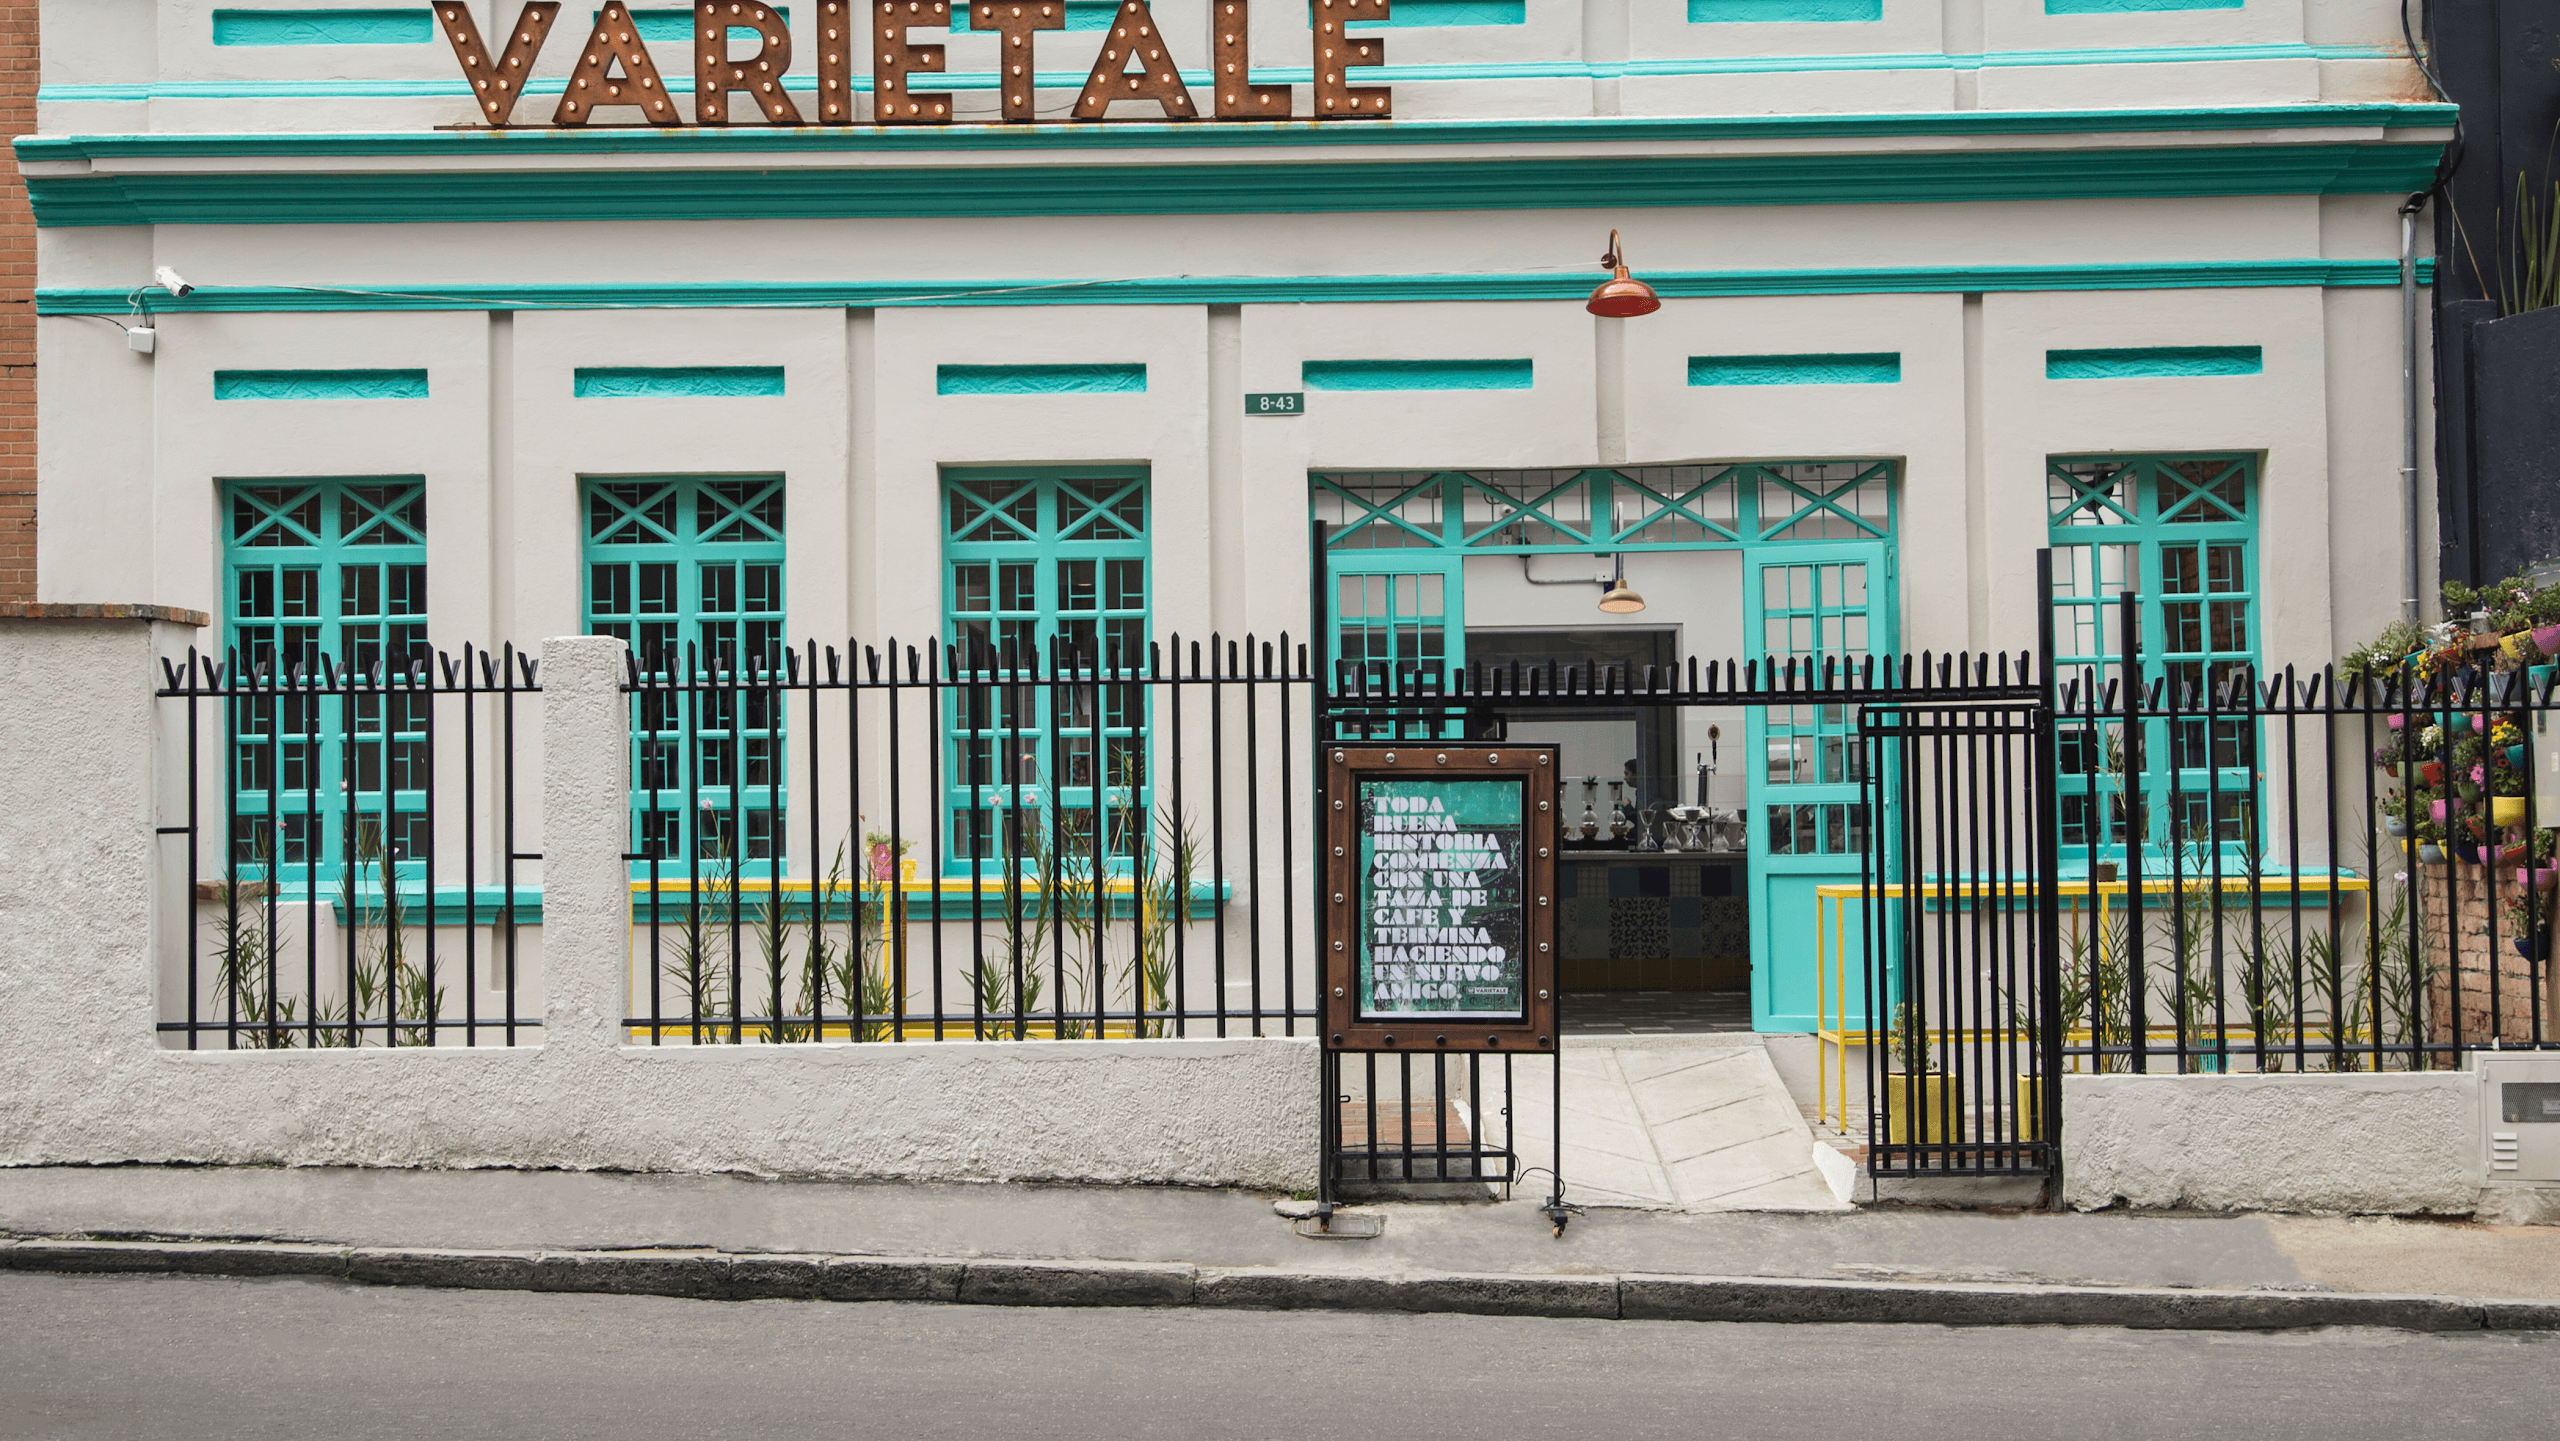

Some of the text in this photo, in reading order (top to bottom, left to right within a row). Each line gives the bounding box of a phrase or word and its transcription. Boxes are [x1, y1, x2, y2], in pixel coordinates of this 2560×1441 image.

[431, 0, 1392, 125] VARIETALE
[1260, 396, 1294, 411] 8-43
[1374, 797, 1444, 813] TODA
[1374, 815, 1458, 831] BUENA
[1374, 834, 1500, 850] HISTORIA
[1374, 852, 1508, 869] COMIENZA
[1374, 871, 1481, 888] CON UNA
[1374, 890, 1487, 906] TAZA DE
[1374, 909, 1466, 925] CAFE Y
[1374, 927, 1492, 944] TERMINA
[1374, 946, 1506, 962] HACIENDO
[1415, 964, 1500, 981] NUEVO
[1374, 983, 1463, 1000] AMIGO.
